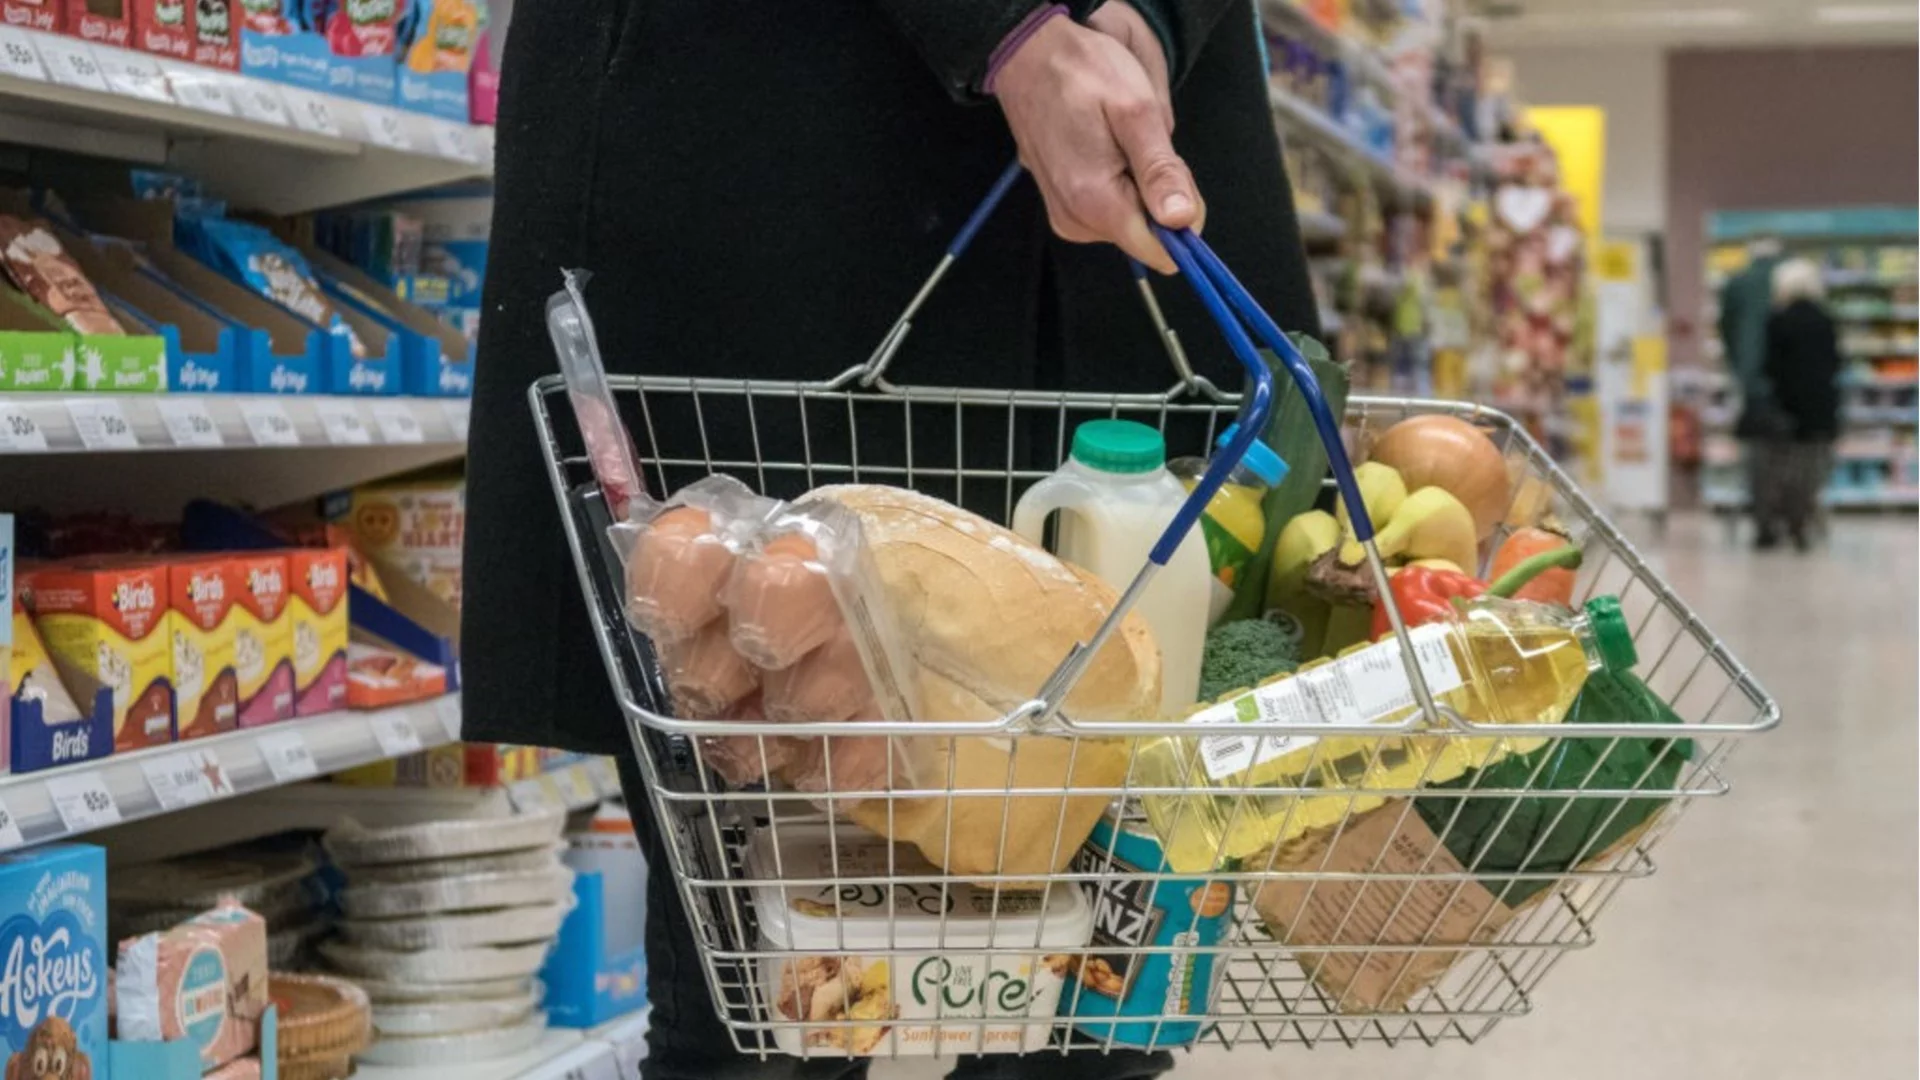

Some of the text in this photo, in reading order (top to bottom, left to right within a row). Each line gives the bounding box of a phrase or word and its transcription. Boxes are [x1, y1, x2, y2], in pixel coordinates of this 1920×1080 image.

[0, 926, 97, 1028] Askeys
[911, 955, 1028, 1011] Pure
[902, 1027, 1022, 1044] Sunfower prea
